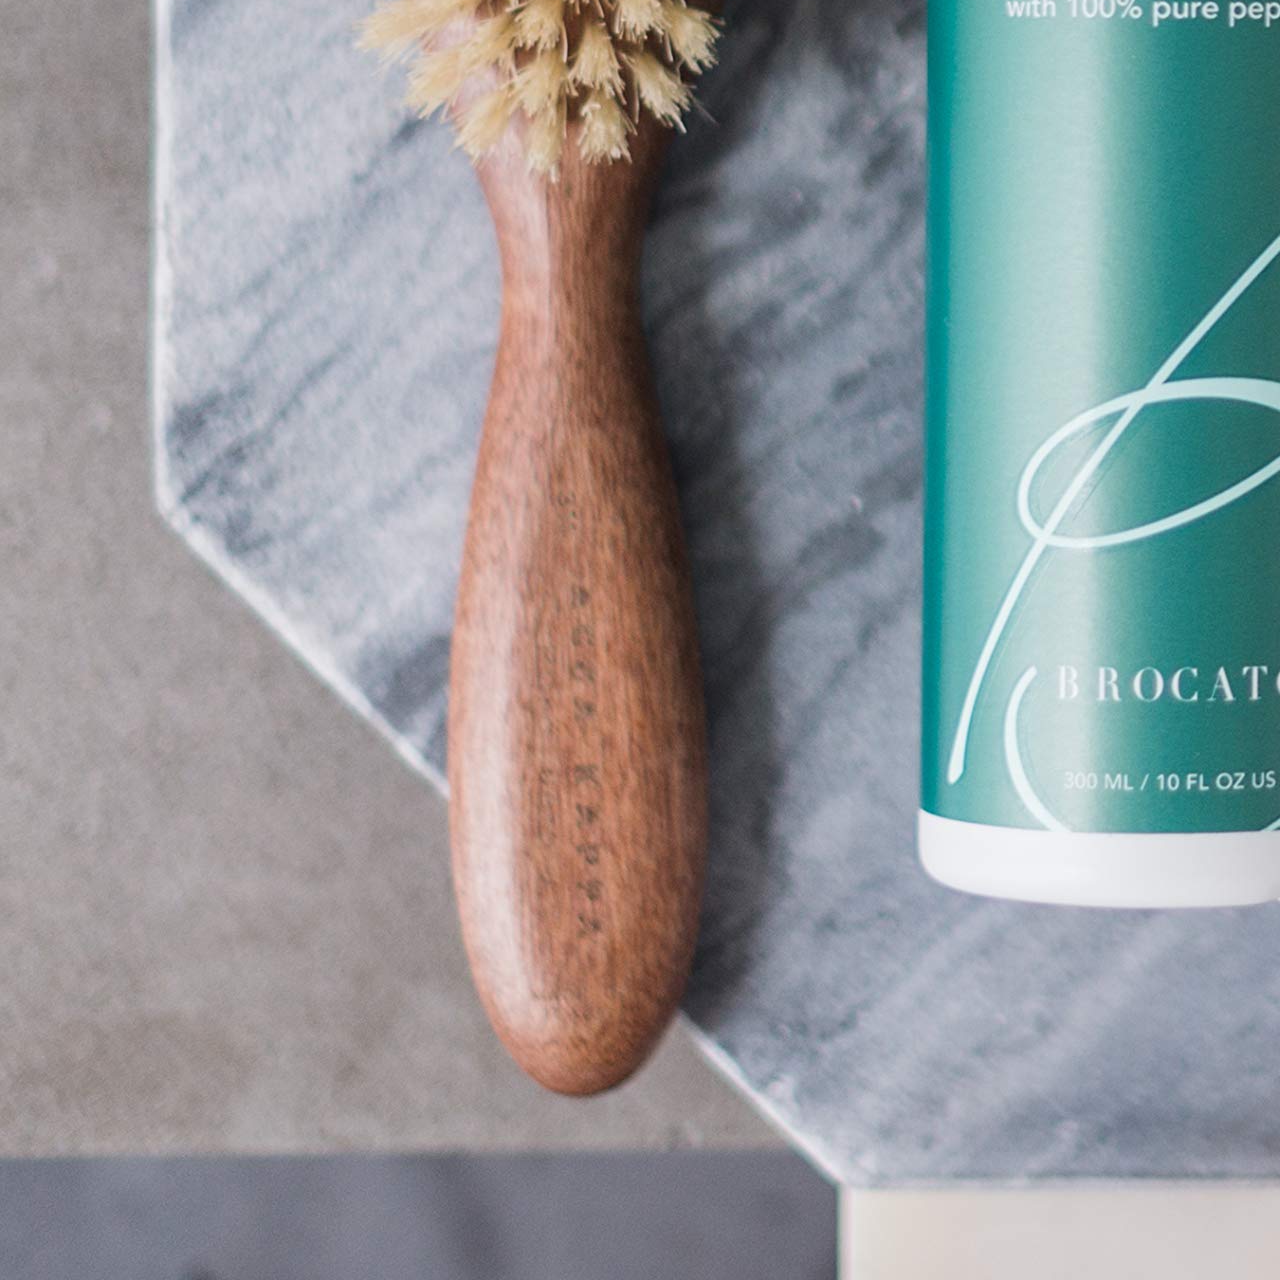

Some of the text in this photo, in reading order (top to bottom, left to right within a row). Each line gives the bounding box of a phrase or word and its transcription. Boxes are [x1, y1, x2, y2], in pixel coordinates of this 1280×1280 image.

[1152, 0, 1220, 27] pure
[1063, 772, 1098, 790] 300
[1104, 773, 1134, 790] ML
[1140, 774, 1150, 790] /
[1156, 773, 1180, 790] 10
[1186, 773, 1210, 790] FL
[1215, 772, 1246, 790] OZ
[1252, 770, 1276, 789] US
